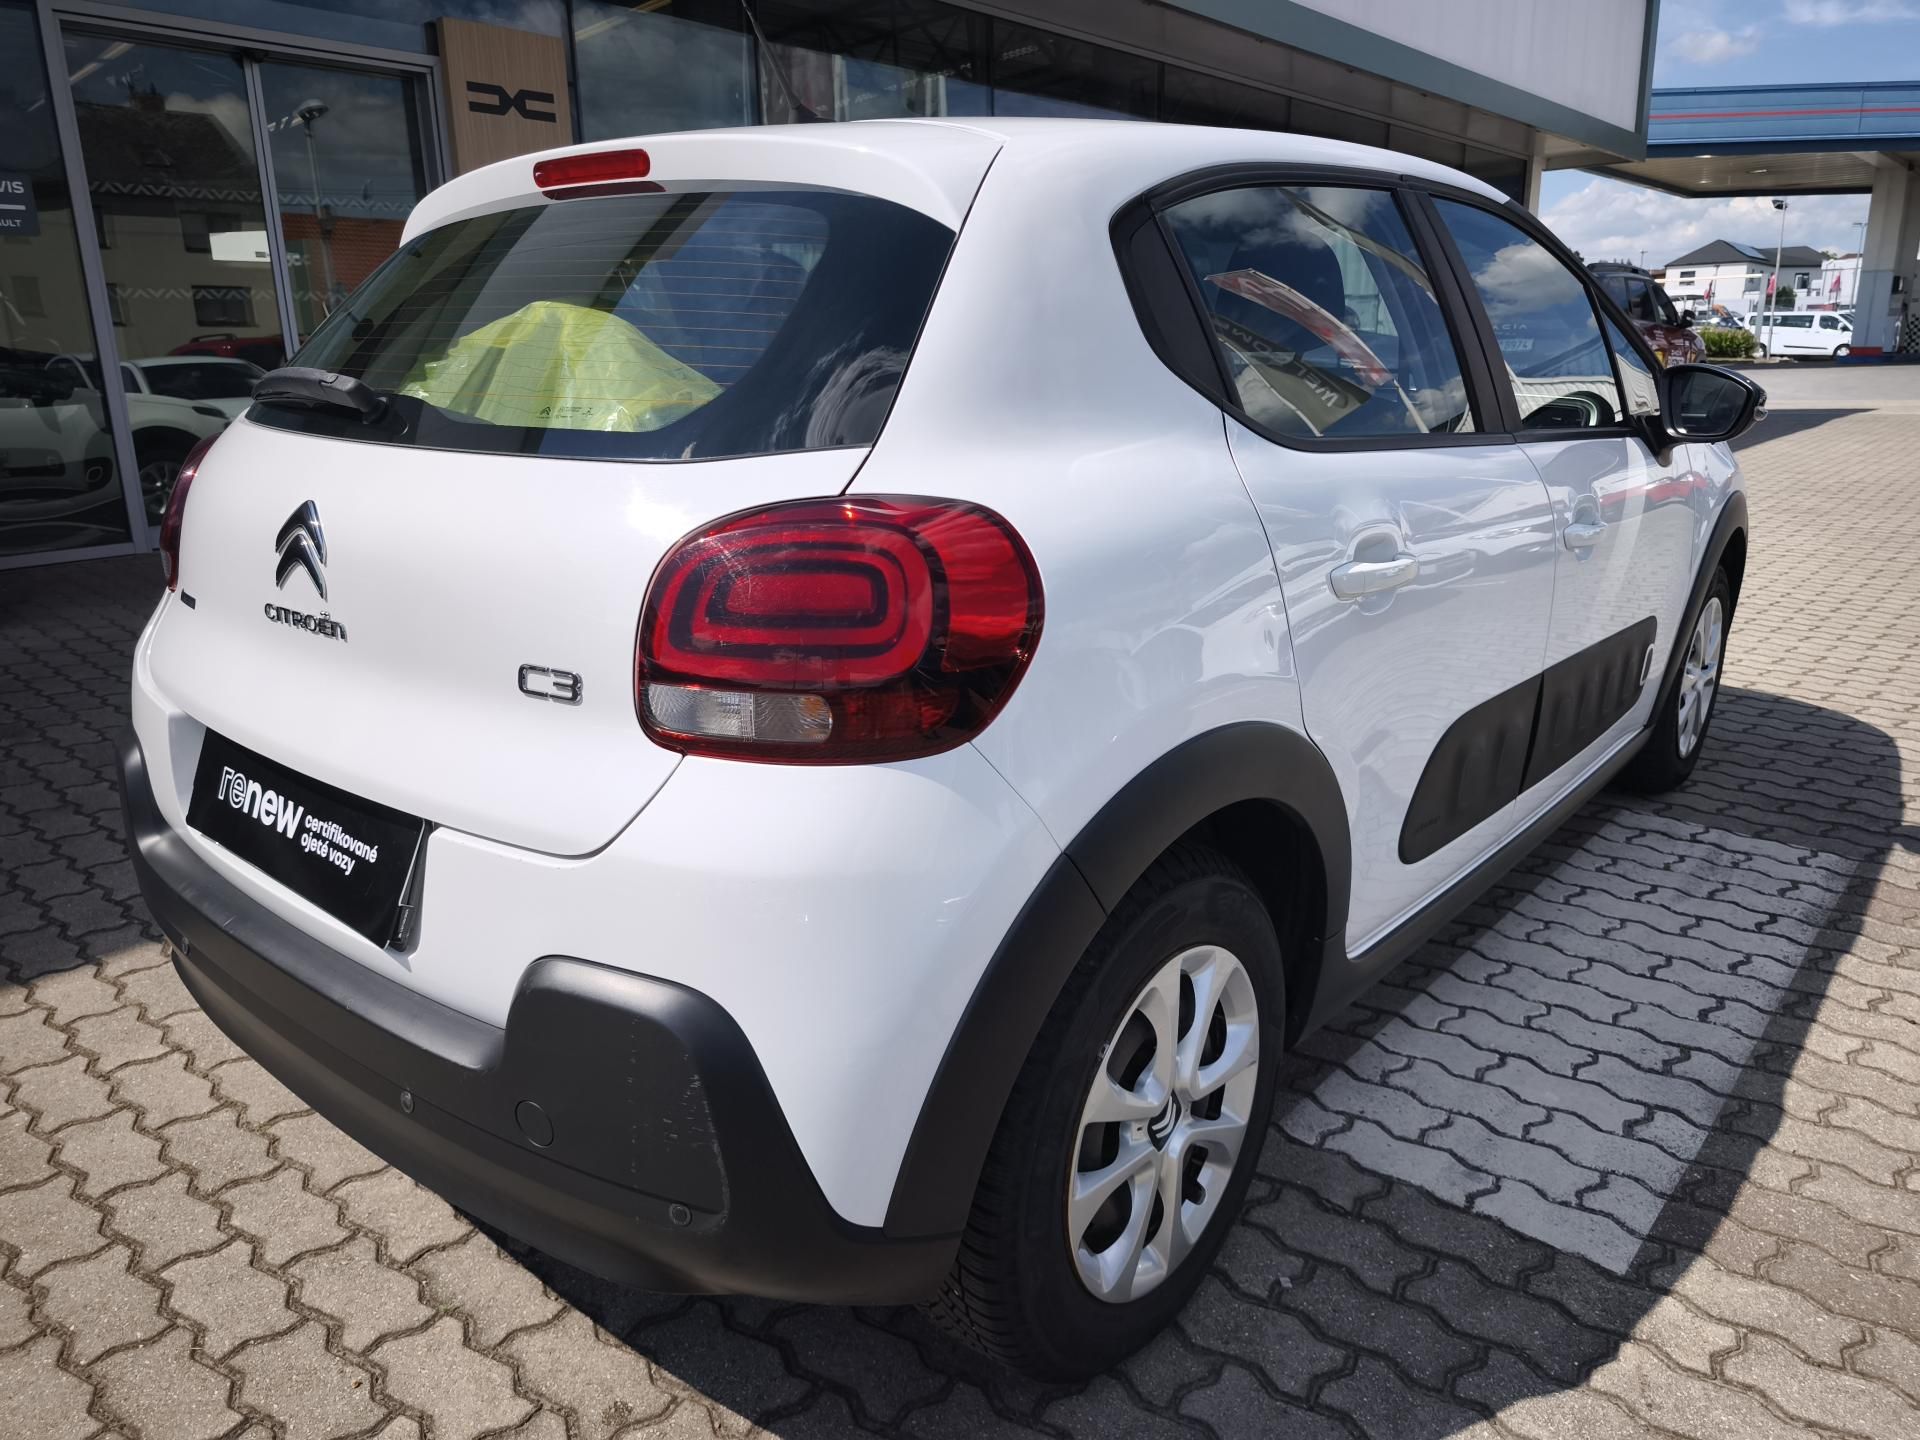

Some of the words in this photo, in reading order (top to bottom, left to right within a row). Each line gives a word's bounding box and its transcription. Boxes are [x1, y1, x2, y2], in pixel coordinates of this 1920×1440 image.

[264, 603, 347, 642] CITROËN
[518, 663, 583, 706] C3
[218, 765, 304, 839] renew
[301, 832, 329, 858] ojeté
[329, 847, 355, 875] vozy
[304, 814, 378, 864] certifikované
